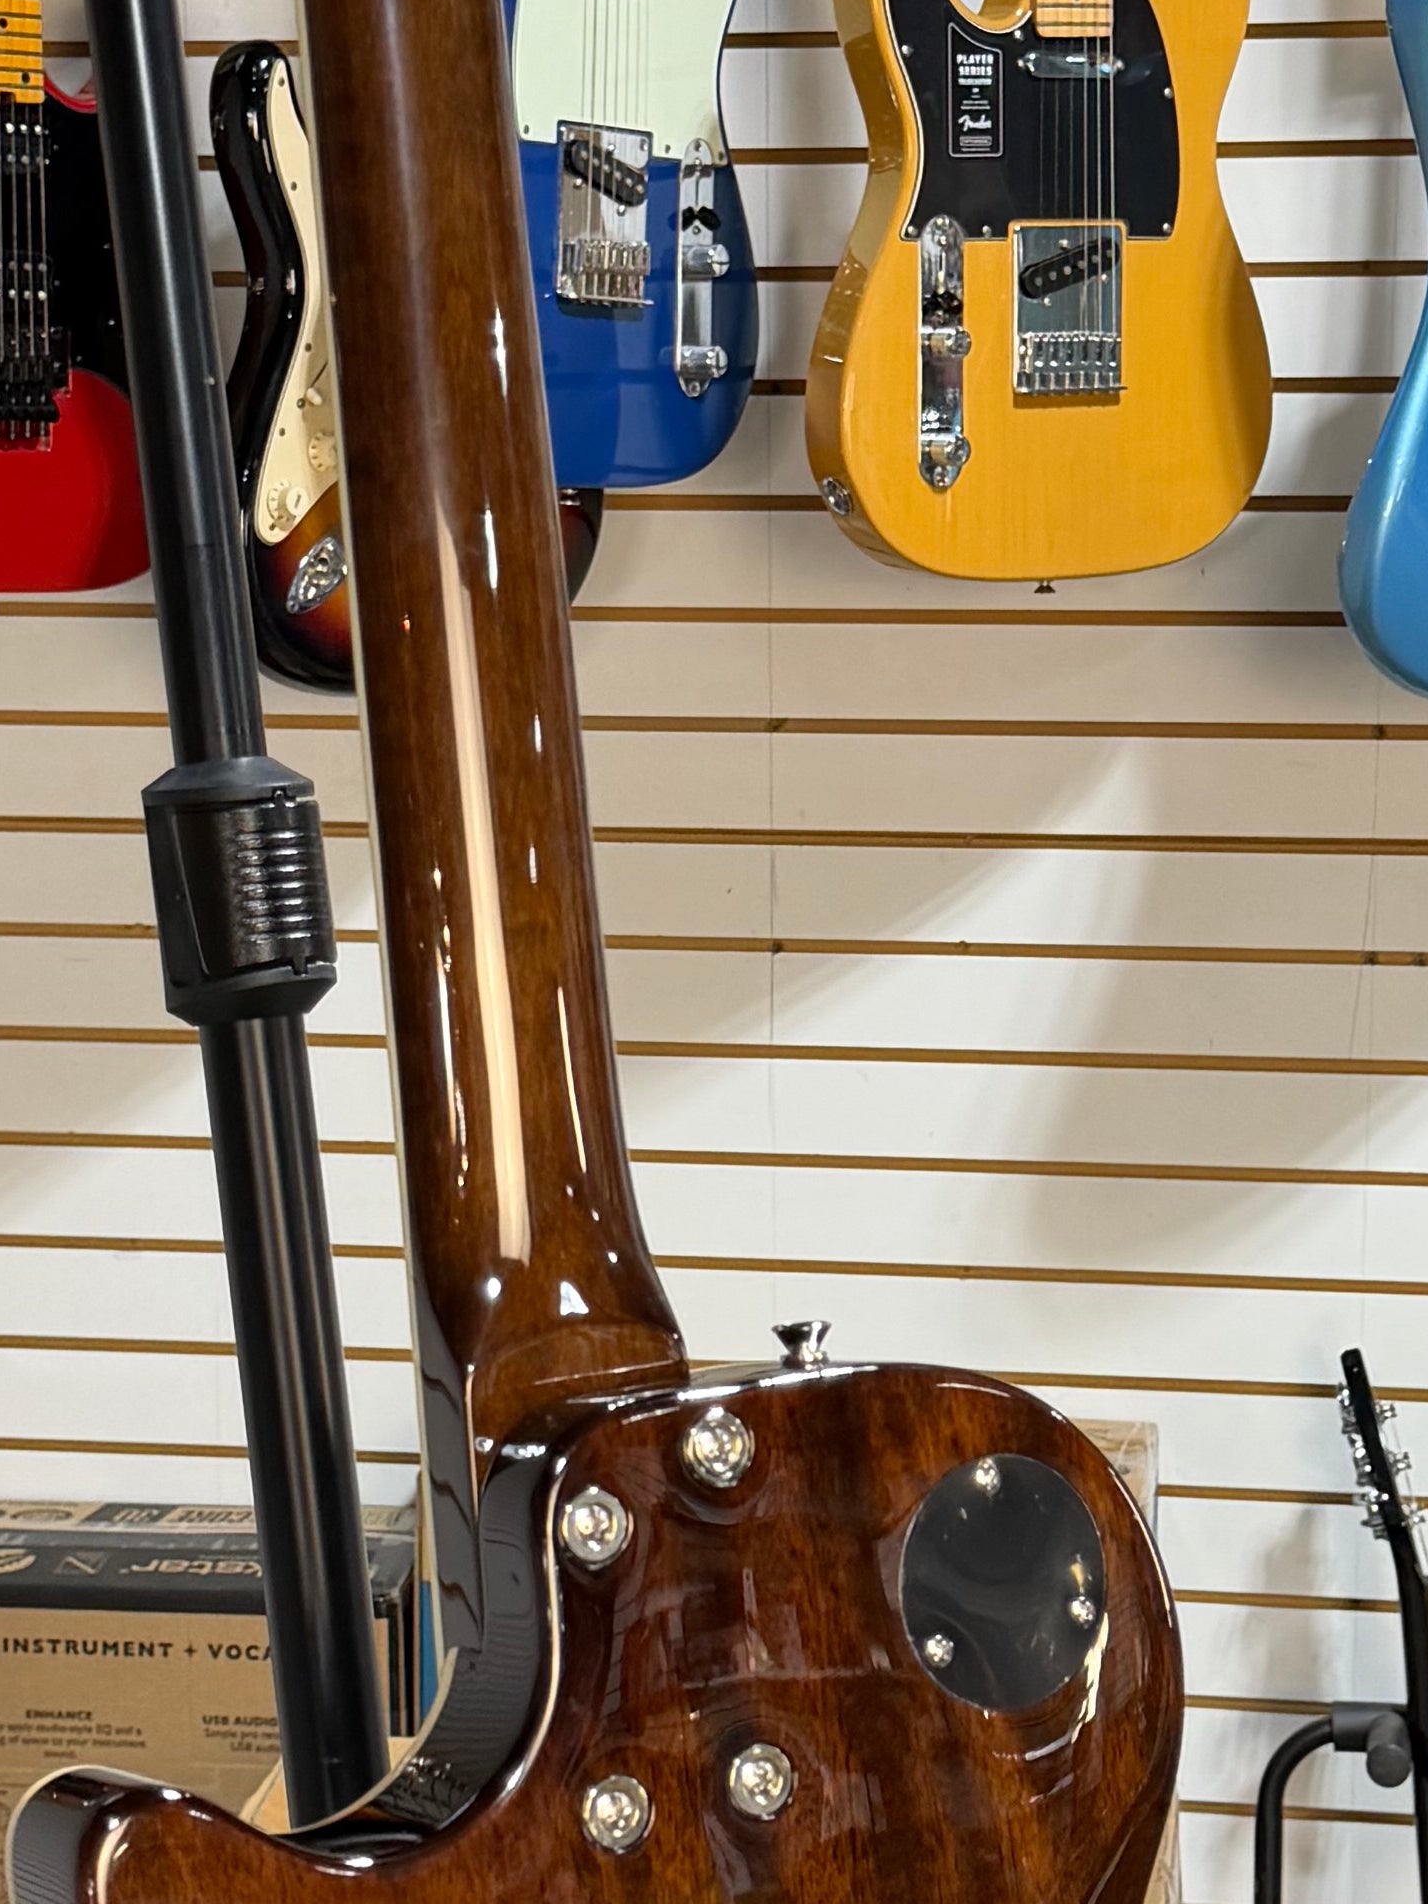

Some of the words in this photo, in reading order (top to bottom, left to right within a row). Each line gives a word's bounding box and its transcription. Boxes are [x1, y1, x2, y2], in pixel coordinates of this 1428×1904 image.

[956, 53, 994, 65] PLAYER
[957, 65, 993, 76] SERIES
[957, 114, 993, 132] Fender
[1, 1637, 174, 1659] INSTRUMENT
